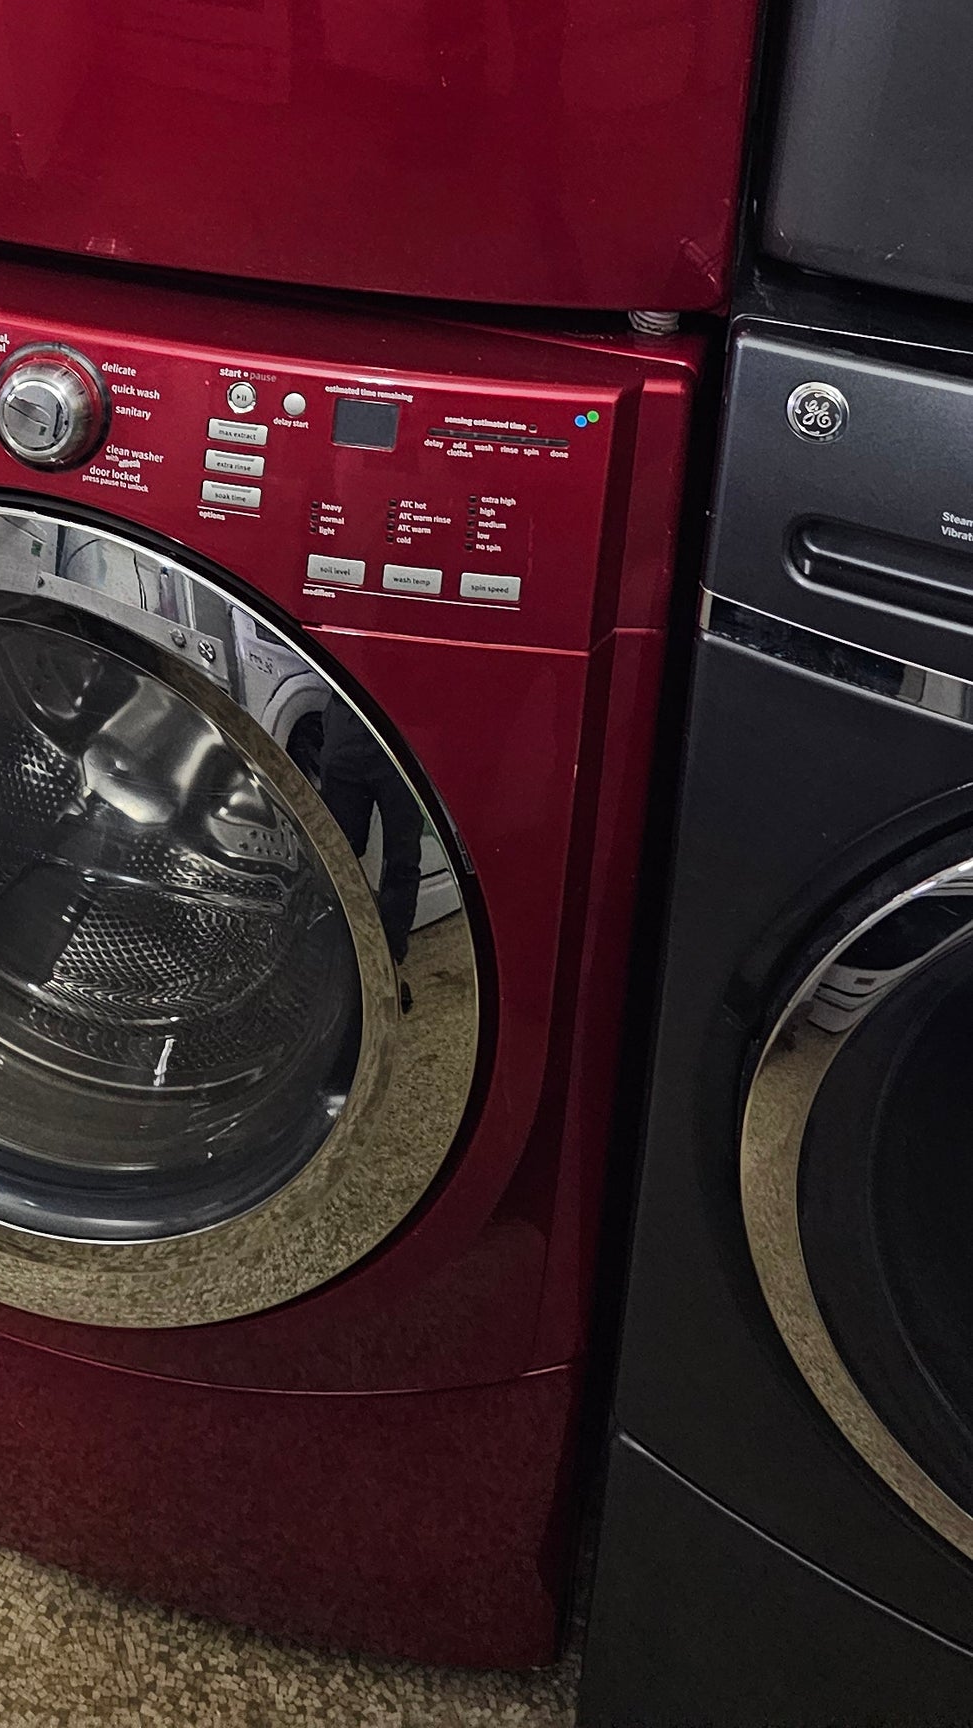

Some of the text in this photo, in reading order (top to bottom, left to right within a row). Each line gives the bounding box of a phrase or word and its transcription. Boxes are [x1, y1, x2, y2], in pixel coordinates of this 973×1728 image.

[101, 362, 137, 377] delicate
[219, 367, 277, 383] start pause
[111, 383, 161, 400] quick wash
[325, 384, 414, 403] estimated time remaining
[115, 405, 151, 421] sanitary
[273, 418, 309, 430] delay start
[219, 428, 257, 441] max extract
[423, 438, 444, 450] delay
[106, 444, 164, 463] clean washer
[447, 448, 473, 460] clothes
[453, 441, 569, 460] add wash rinse spin done
[105, 454, 119, 462] with
[217, 461, 251, 472] extra rinse
[89, 465, 141, 484] door locked
[82, 474, 149, 493] press pause to unlock
[399, 500, 427, 511] ATC hot
[481, 496, 517, 507] extra high
[321, 502, 343, 514] heavy
[479, 506, 496, 518] high
[199, 510, 225, 521] options
[320, 514, 345, 526] normal
[399, 512, 451, 525] ATC warm rinse
[397, 524, 431, 535] ATC warm
[478, 519, 507, 530] medium
[319, 526, 335, 537] light
[477, 531, 490, 540] low
[397, 536, 411, 545] cold
[475, 542, 502, 554] no spin
[319, 565, 351, 576] soil level
[393, 576, 431, 588] wash temp
[303, 587, 336, 599] modifiers
[471, 584, 509, 596] spin speed
